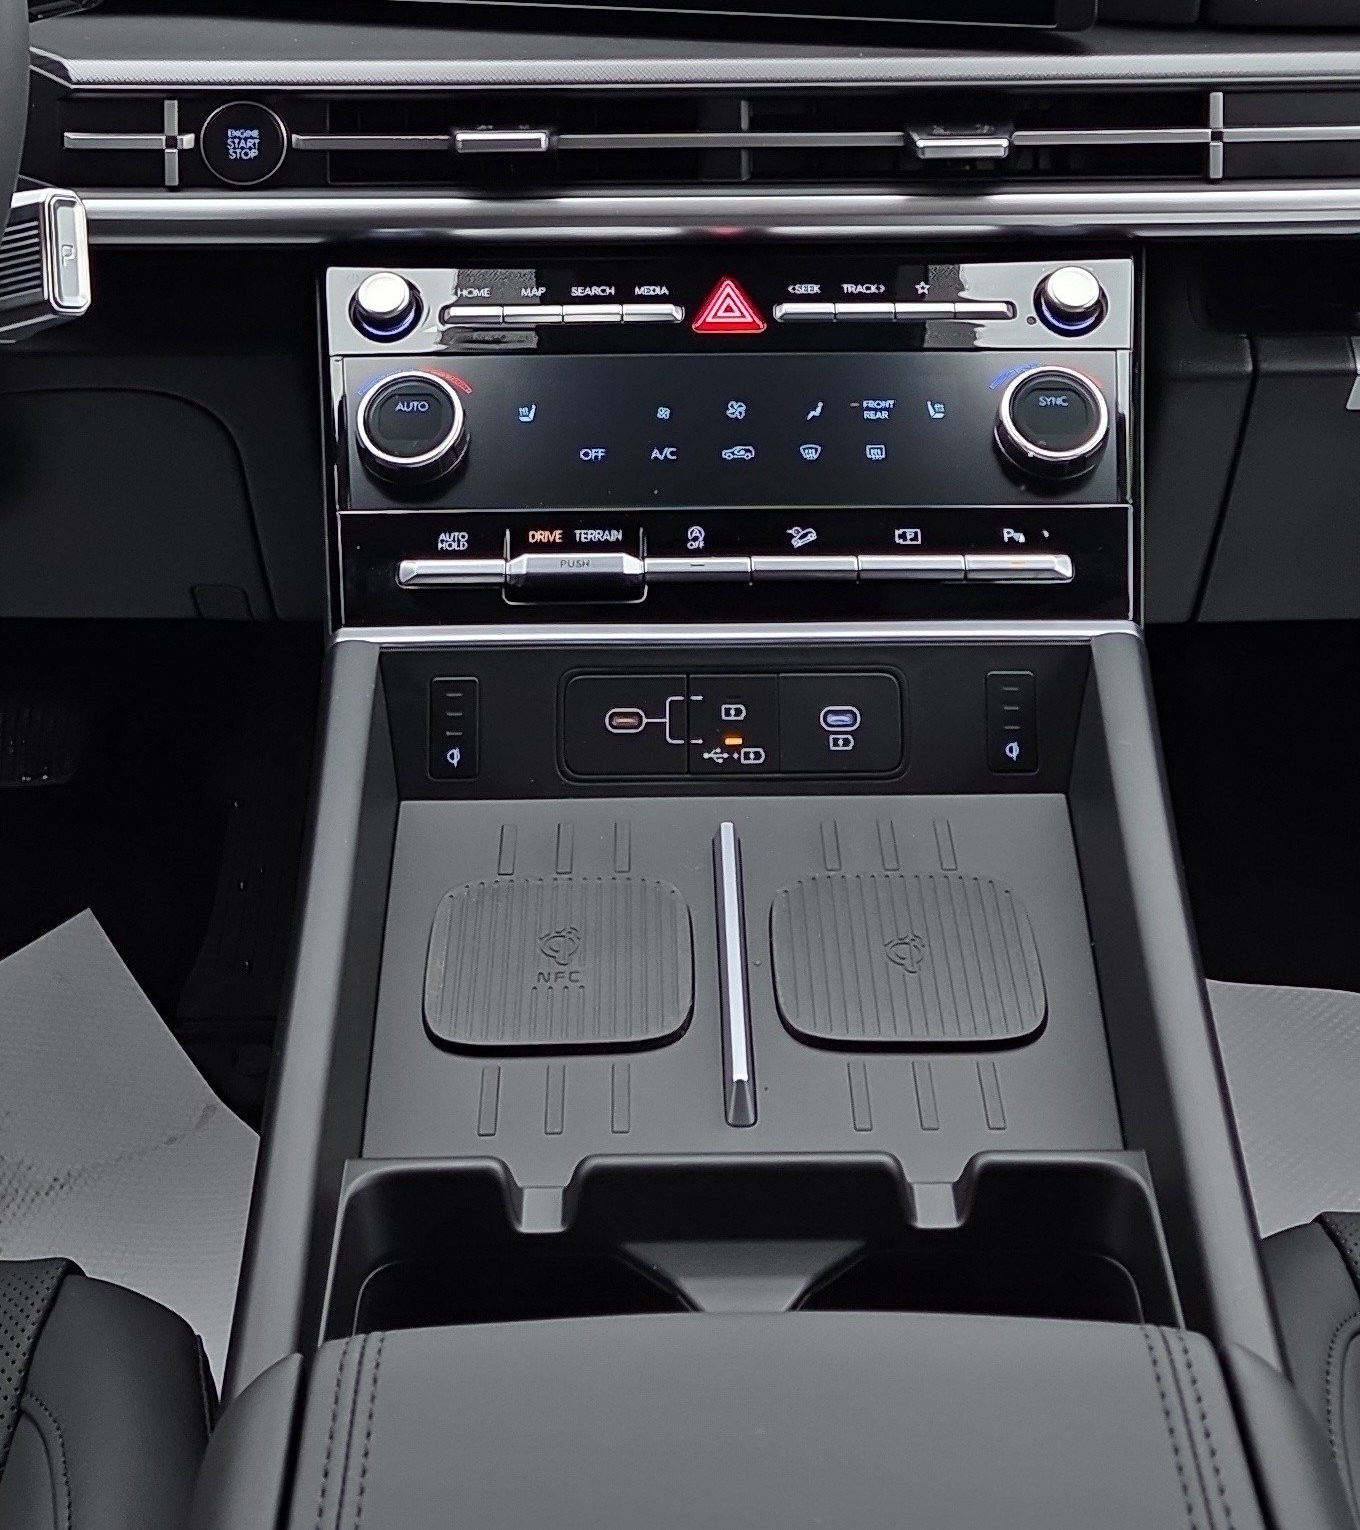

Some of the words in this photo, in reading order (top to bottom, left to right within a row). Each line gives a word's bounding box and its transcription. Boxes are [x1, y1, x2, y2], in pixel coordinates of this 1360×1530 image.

[227, 128, 260, 138] ENGINE
[226, 138, 261, 150] START
[228, 149, 259, 160] STOP
[456, 286, 491, 298] HOME
[520, 286, 547, 297] MAP
[570, 285, 615, 297] SEARCH
[634, 285, 670, 296] MEDIA
[394, 400, 429, 412] AUTO
[862, 399, 896, 409] FRONT
[1038, 395, 1069, 407] SYNC
[863, 410, 889, 420] REAR
[579, 448, 607, 461] OFF
[651, 447, 677, 460] A/C
[438, 531, 469, 542] AUTO
[528, 530, 563, 543] DRIVE
[574, 529, 623, 542] TERRAIN
[437, 541, 468, 551] HOLD
[687, 541, 705, 550] OFF
[560, 559, 591, 569] PUSH
[536, 971, 580, 983] NFC
